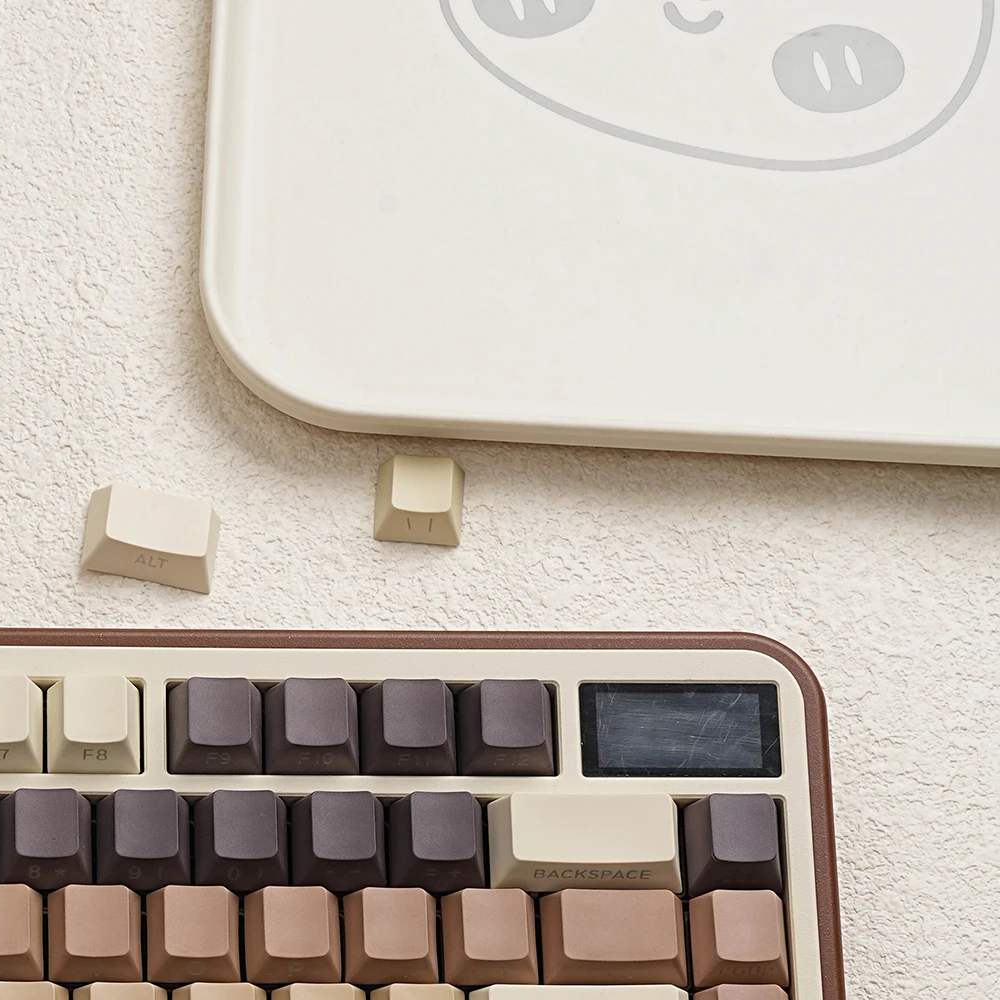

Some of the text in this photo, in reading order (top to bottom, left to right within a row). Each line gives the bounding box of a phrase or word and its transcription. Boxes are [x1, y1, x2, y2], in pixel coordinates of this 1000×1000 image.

[134, 553, 168, 569] ALT
[82, 748, 108, 762] F8
[205, 752, 231, 765] F9
[533, 868, 652, 882] BACKSPACE
